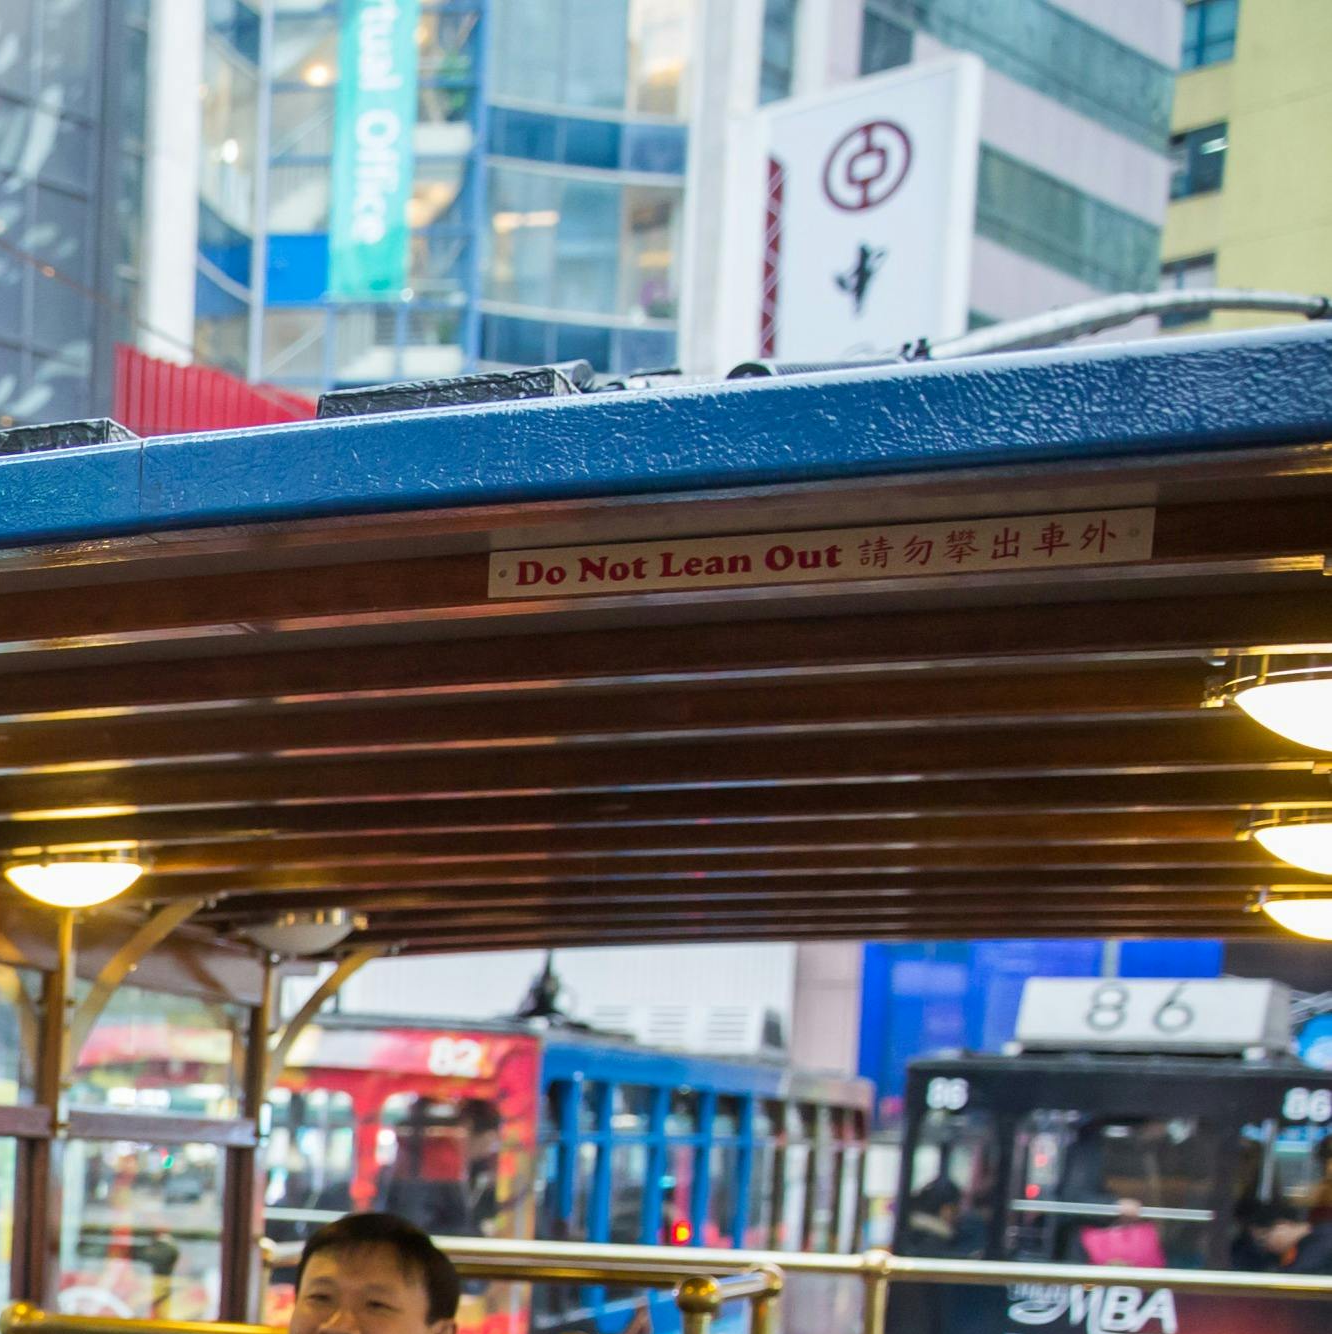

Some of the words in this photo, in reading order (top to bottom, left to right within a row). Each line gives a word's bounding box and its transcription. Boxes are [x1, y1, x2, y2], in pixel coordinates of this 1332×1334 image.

[352, 108, 401, 246] Office
[515, 560, 566, 586] Do
[578, 556, 647, 582] Not
[659, 552, 752, 578] Lean
[765, 545, 842, 571] Out
[857, 519, 1118, 569] 請勿攀出車外
[1085, 981, 1194, 1034] 86
[427, 1036, 482, 1078] 82
[1282, 1086, 1332, 1123] 86
